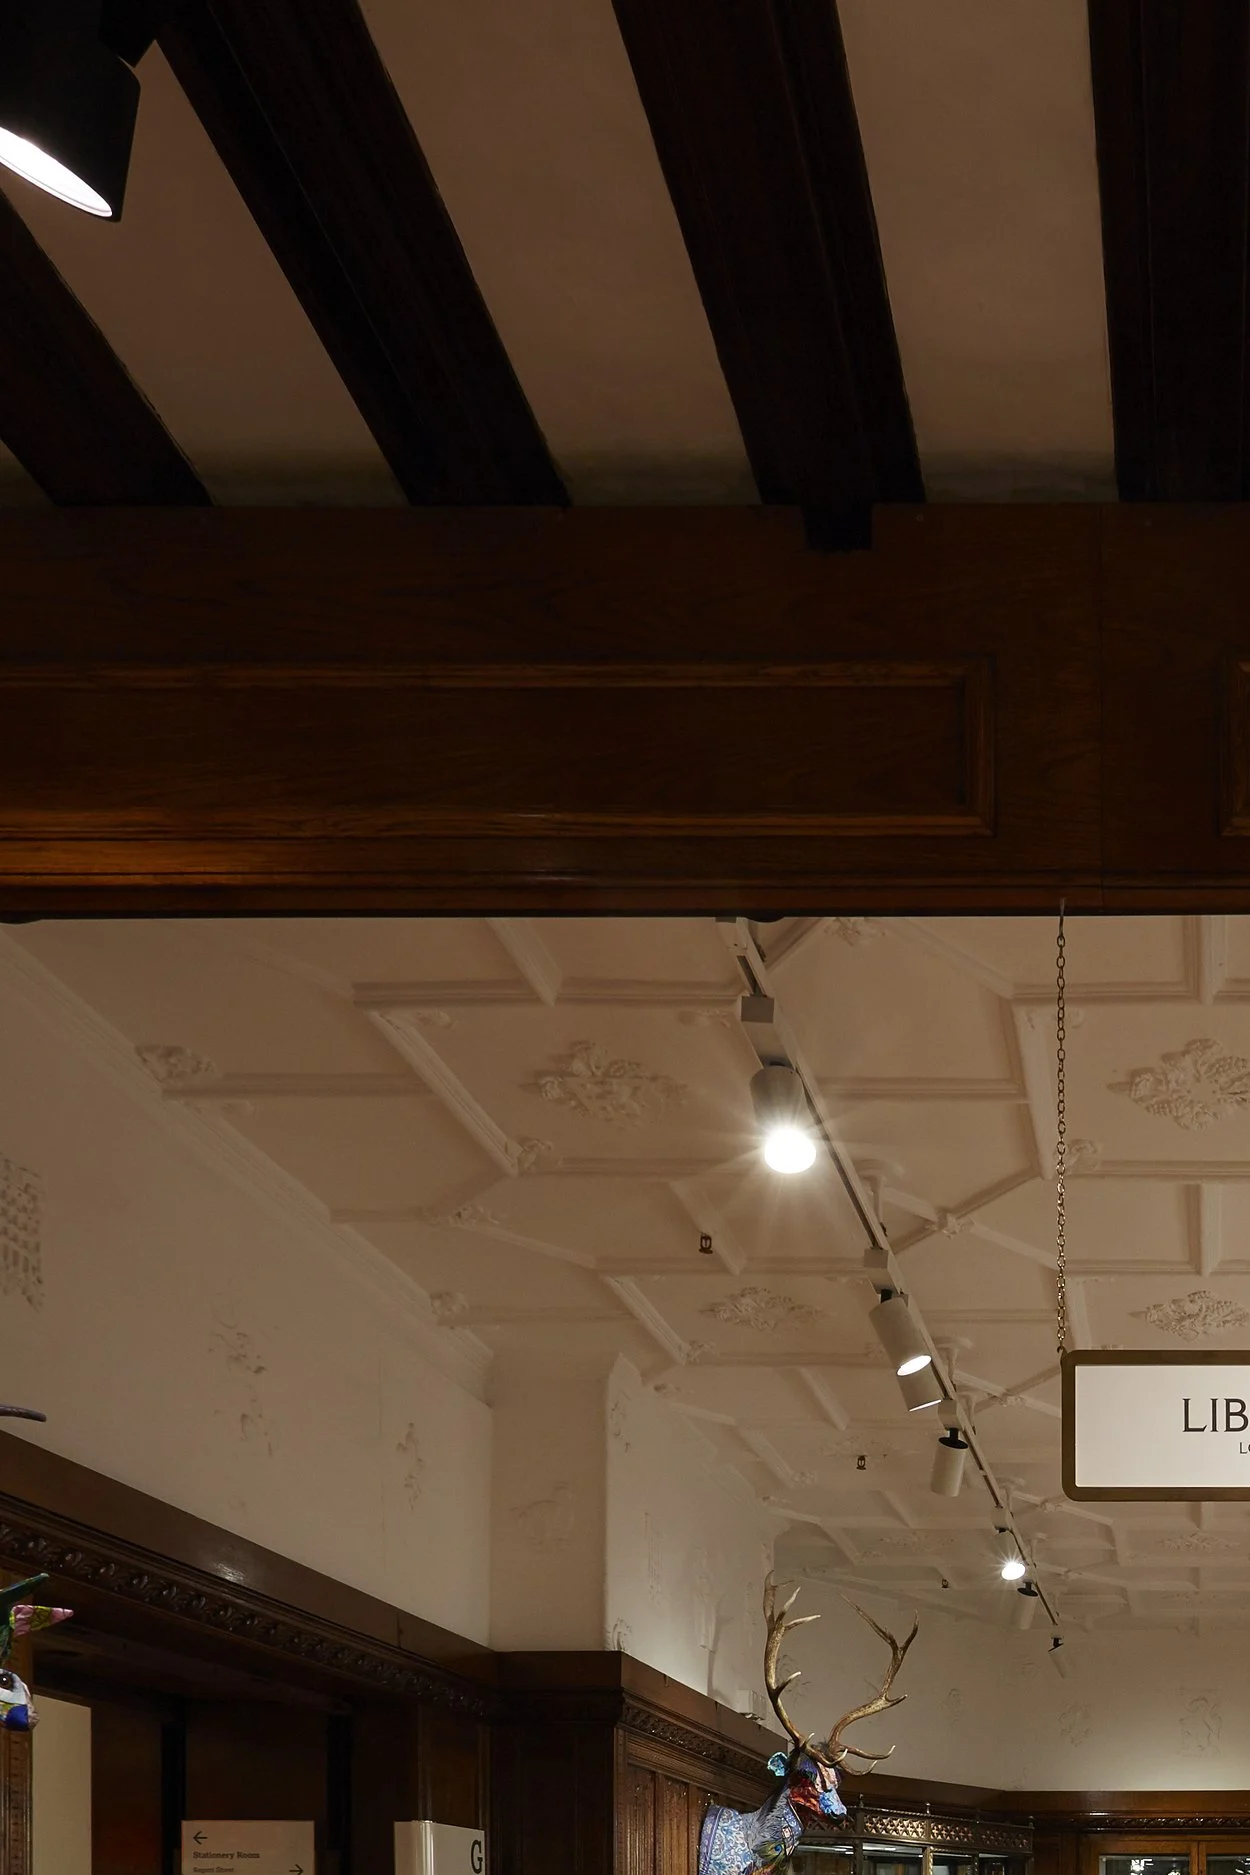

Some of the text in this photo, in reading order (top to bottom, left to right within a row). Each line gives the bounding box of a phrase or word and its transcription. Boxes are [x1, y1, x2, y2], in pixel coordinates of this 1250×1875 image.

[192, 1851, 261, 1860] Stationery Room
[470, 1839, 484, 1875] G
